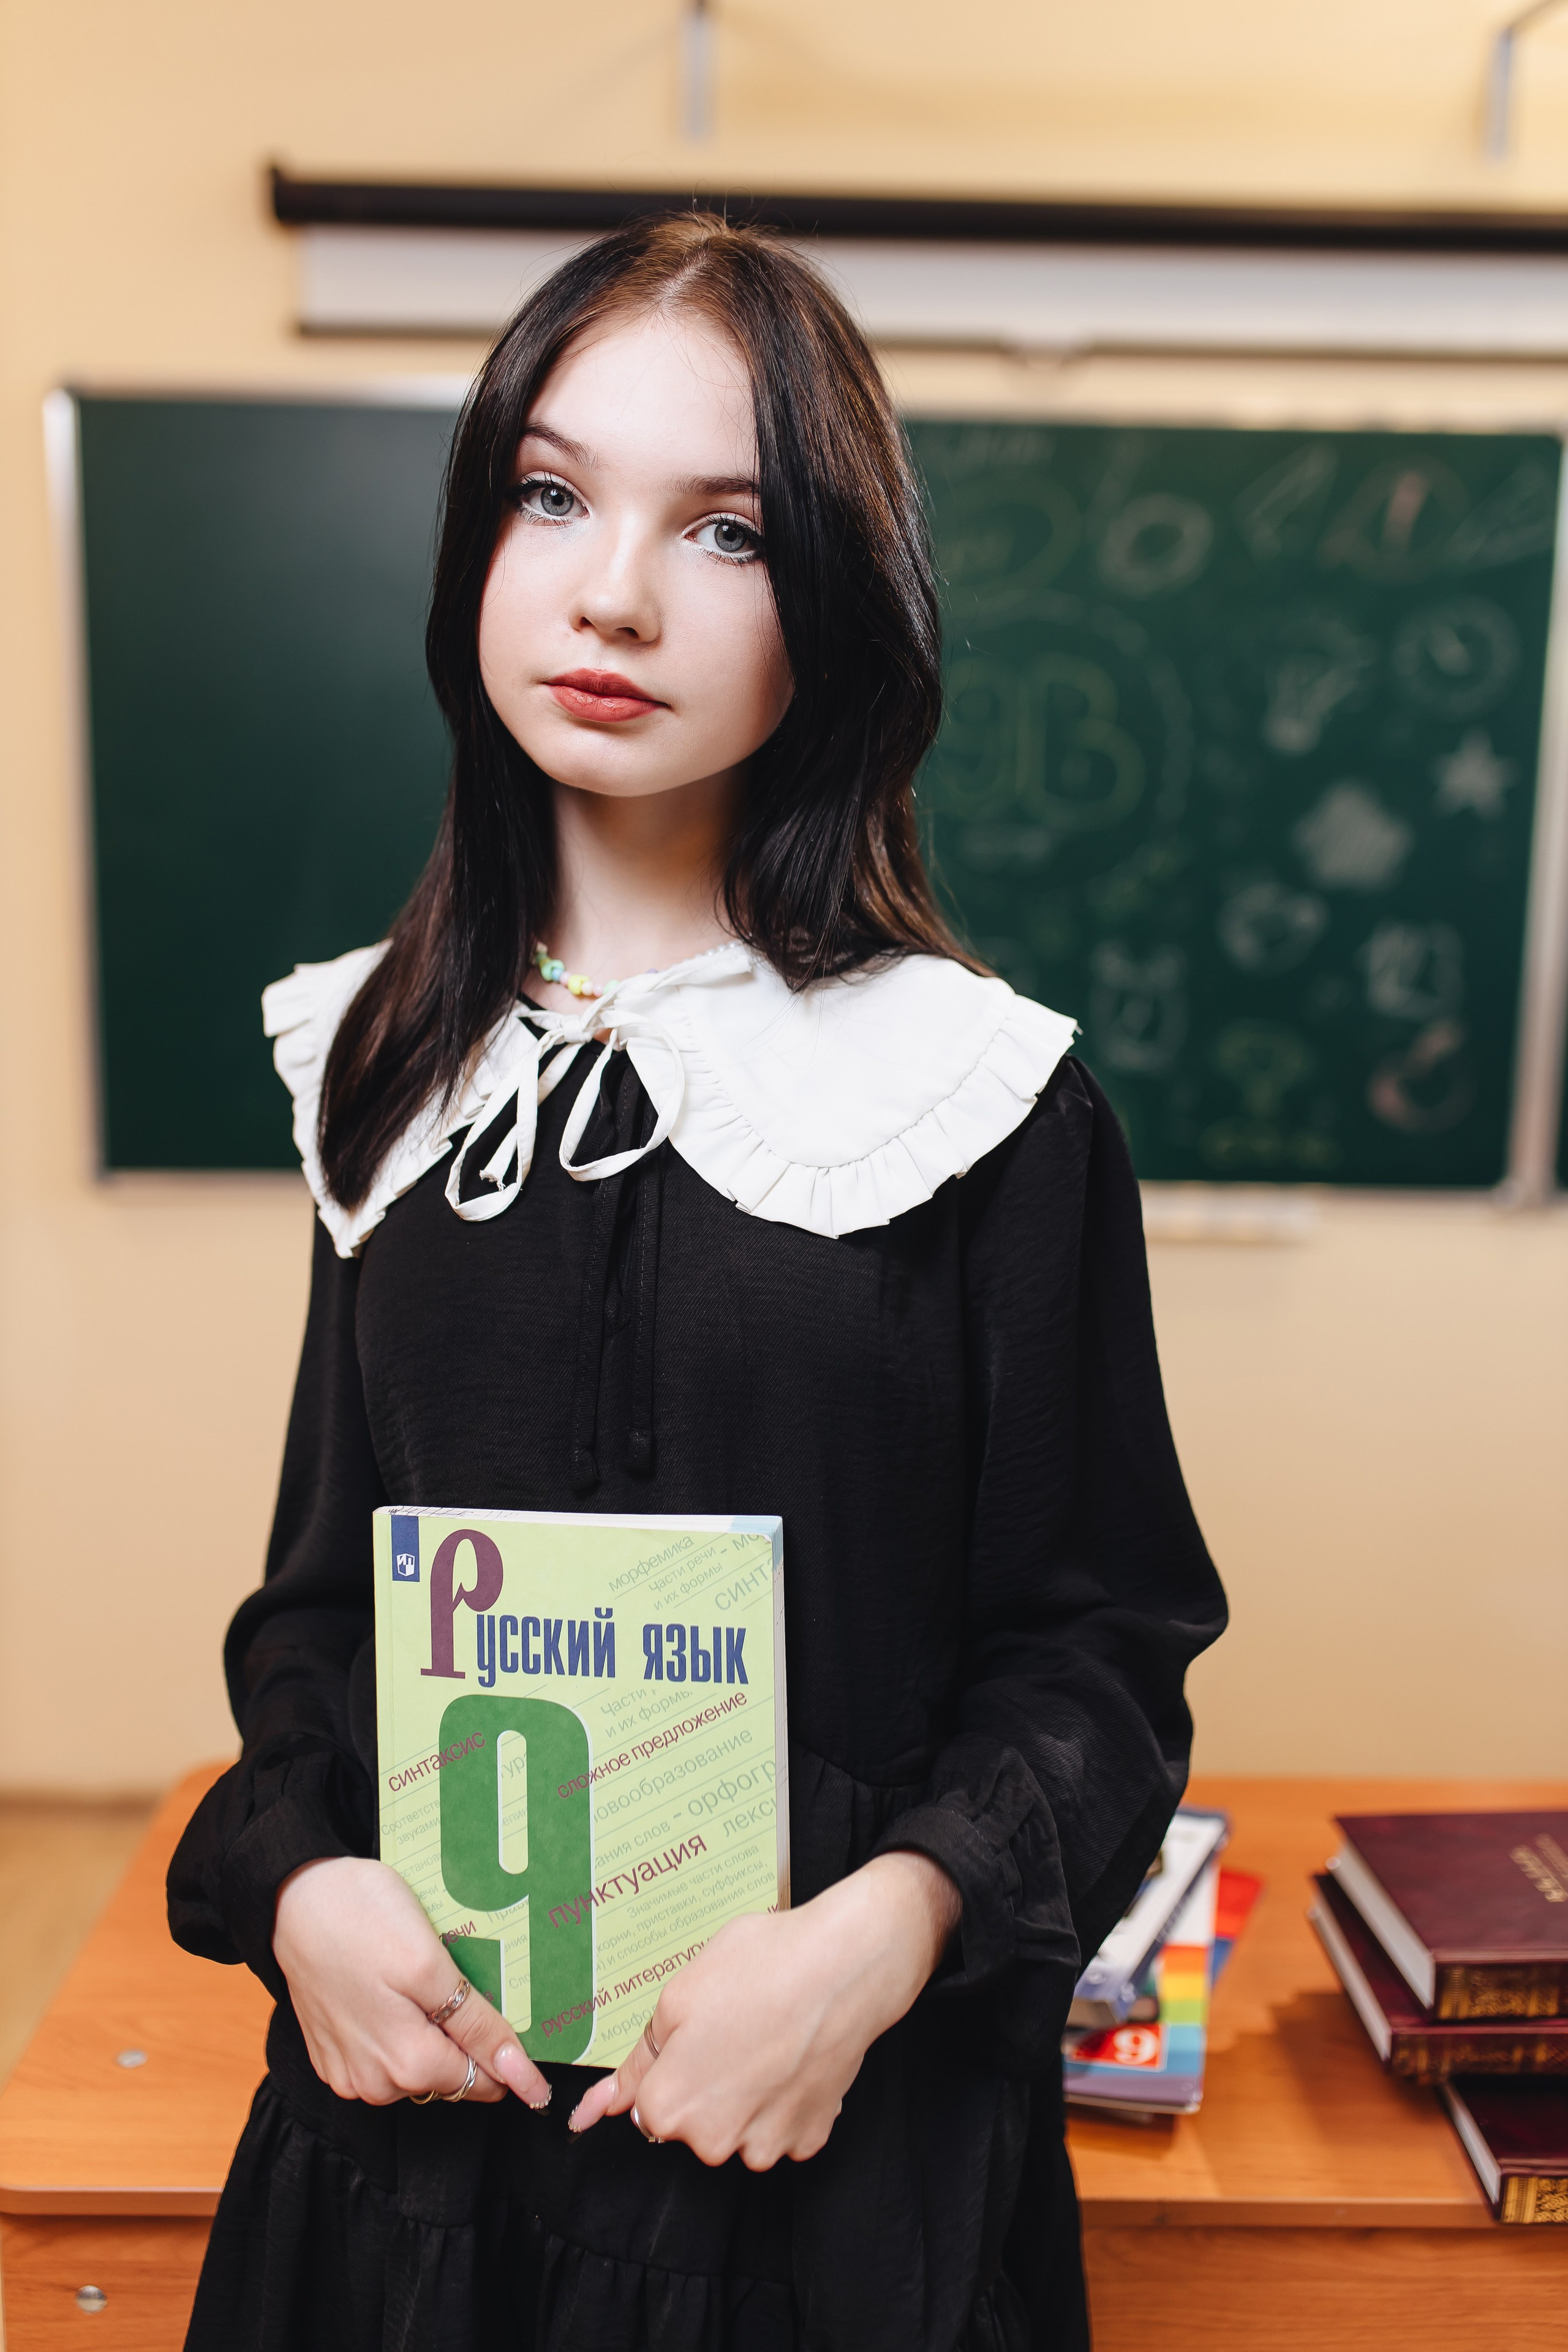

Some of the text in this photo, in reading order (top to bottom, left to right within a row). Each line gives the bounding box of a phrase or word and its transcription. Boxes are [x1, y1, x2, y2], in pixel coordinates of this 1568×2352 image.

[608, 1536, 695, 1592] морфемика
[649, 1546, 716, 1593] Части речи
[654, 1562, 723, 1610] и их формы
[421, 1529, 616, 1688] Русский
[600, 1689, 647, 1717] Части
[605, 1726, 616, 1738] и
[618, 1716, 637, 1732] их
[388, 1732, 486, 1792] синтаксис
[557, 1692, 748, 1799] сложное предложение
[594, 1729, 753, 1823] овообразование
[634, 1822, 671, 1847] слов
[439, 1694, 593, 2064] 9
[548, 1834, 707, 1928] пунктуация
[627, 1845, 759, 1919] Значимые части слова
[608, 1954, 616, 1966] и
[617, 1928, 668, 1961] способы
[669, 1887, 746, 1932] образования
[747, 1872, 776, 1892] слов
[541, 1987, 612, 2039] русский
[600, 2006, 657, 2043] морфо
[1114, 2026, 1158, 2065] 9
